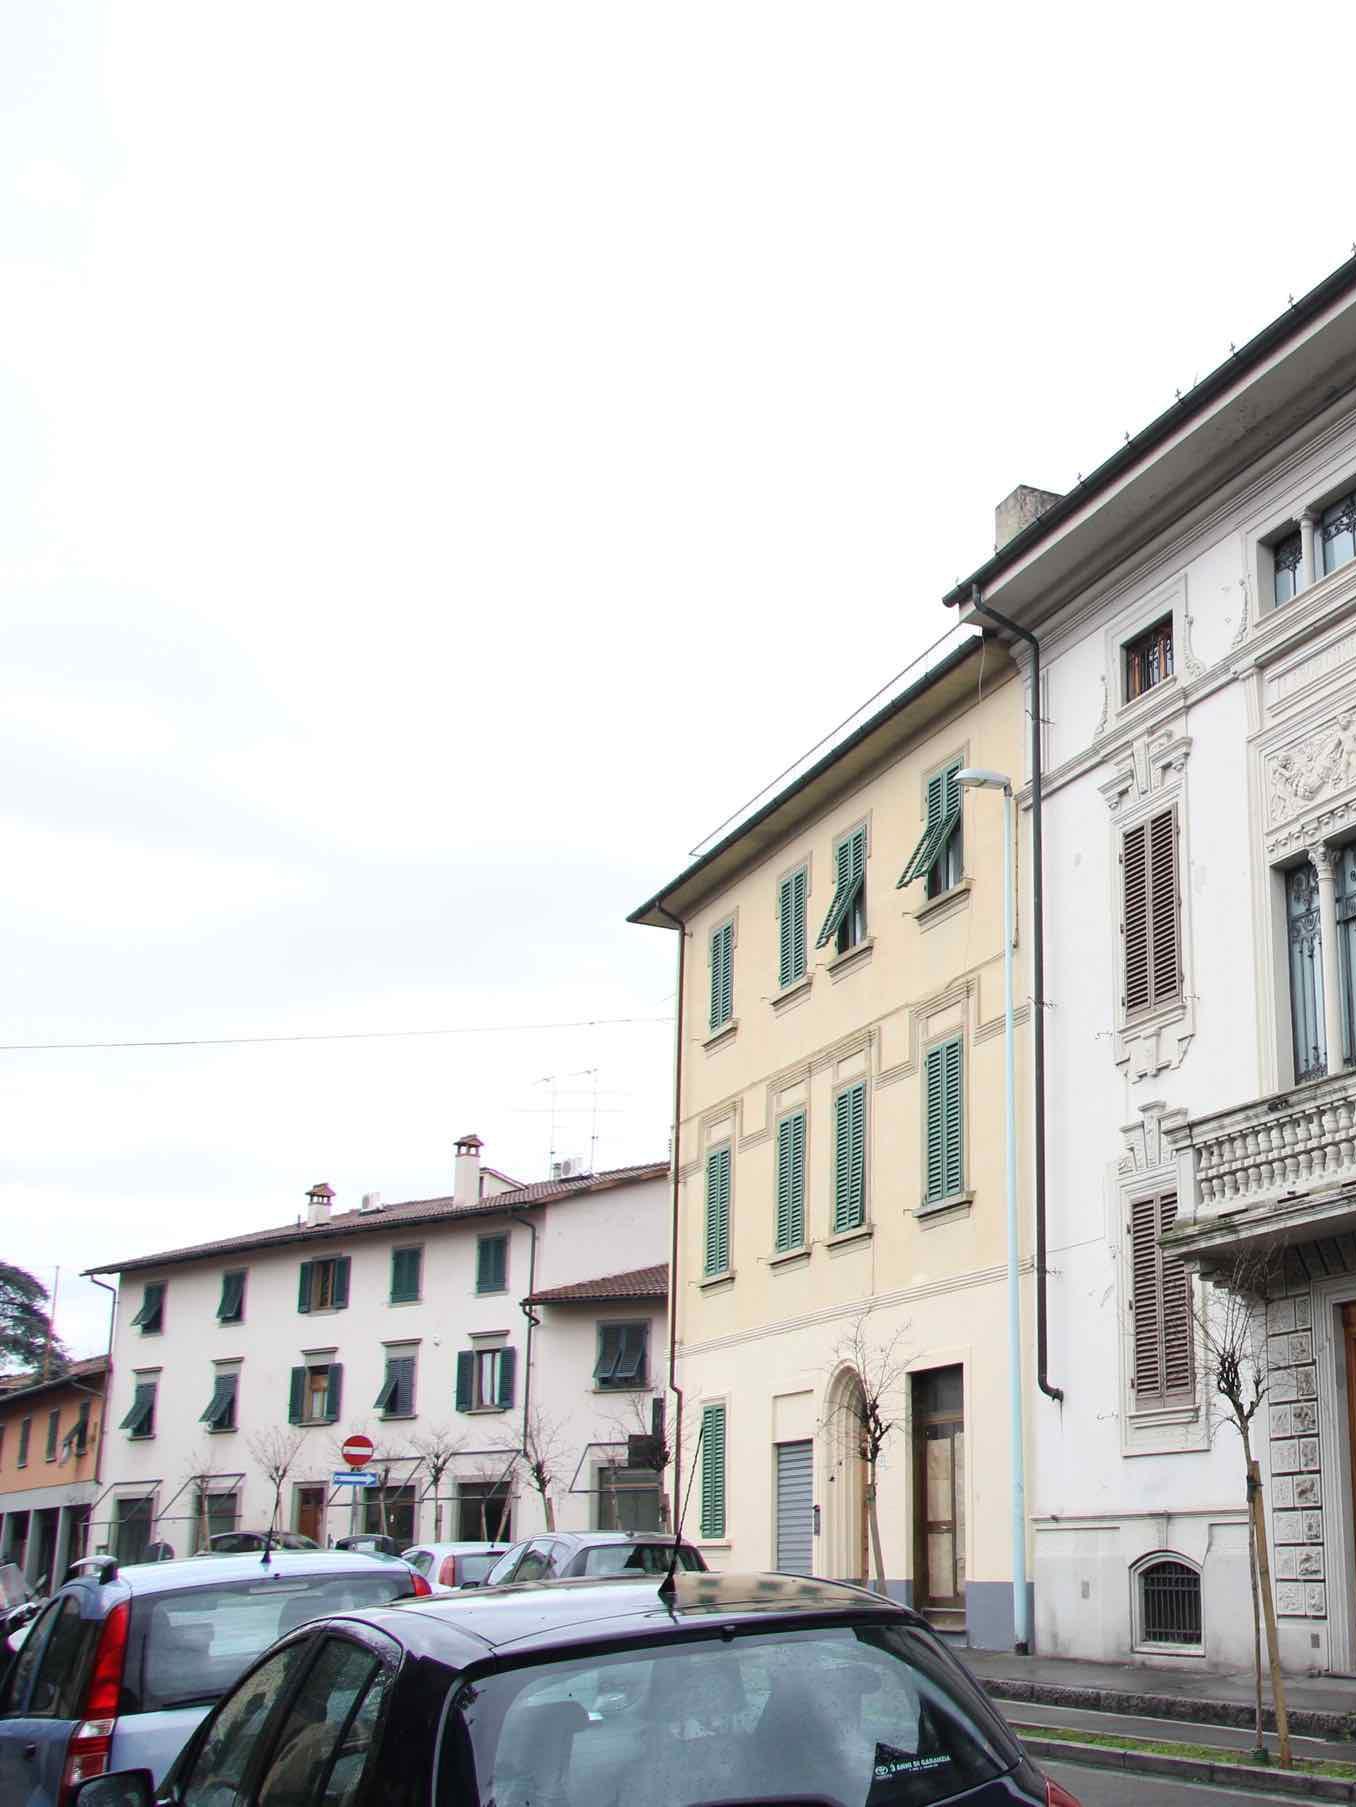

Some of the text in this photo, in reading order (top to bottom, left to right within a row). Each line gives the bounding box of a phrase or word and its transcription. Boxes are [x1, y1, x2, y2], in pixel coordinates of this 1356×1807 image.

[890, 1764, 896, 1772] 3
[896, 1762, 912, 1770] ANNI
[920, 1755, 951, 1765] GARANZIA
